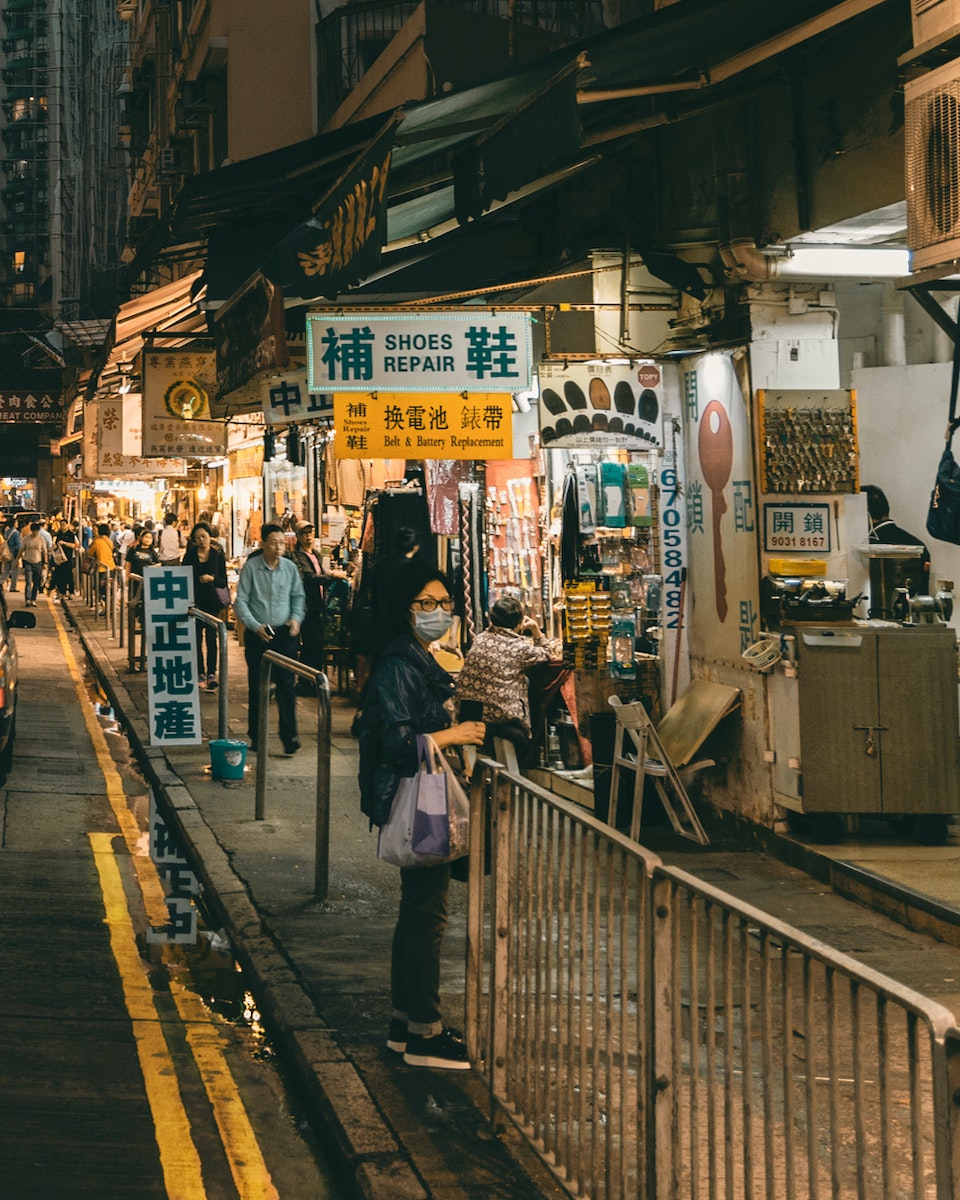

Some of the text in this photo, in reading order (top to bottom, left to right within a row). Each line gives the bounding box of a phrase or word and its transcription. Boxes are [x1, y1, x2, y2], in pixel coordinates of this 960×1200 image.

[385, 334, 452, 350] SHOES
[321, 326, 375, 381] 補
[465, 326, 519, 379] 鞋
[384, 356, 454, 372] REPAIR
[346, 402, 367, 418] 補
[343, 426, 371, 434] Repair
[346, 435, 368, 450] 鞋
[384, 435, 504, 450] Belt & Battery Replacement
[773, 511, 824, 534] 開鎖
[660, 469, 685, 630] 67058482
[771, 536, 825, 547] 9031 8167
[149, 570, 197, 740] 中正地產
